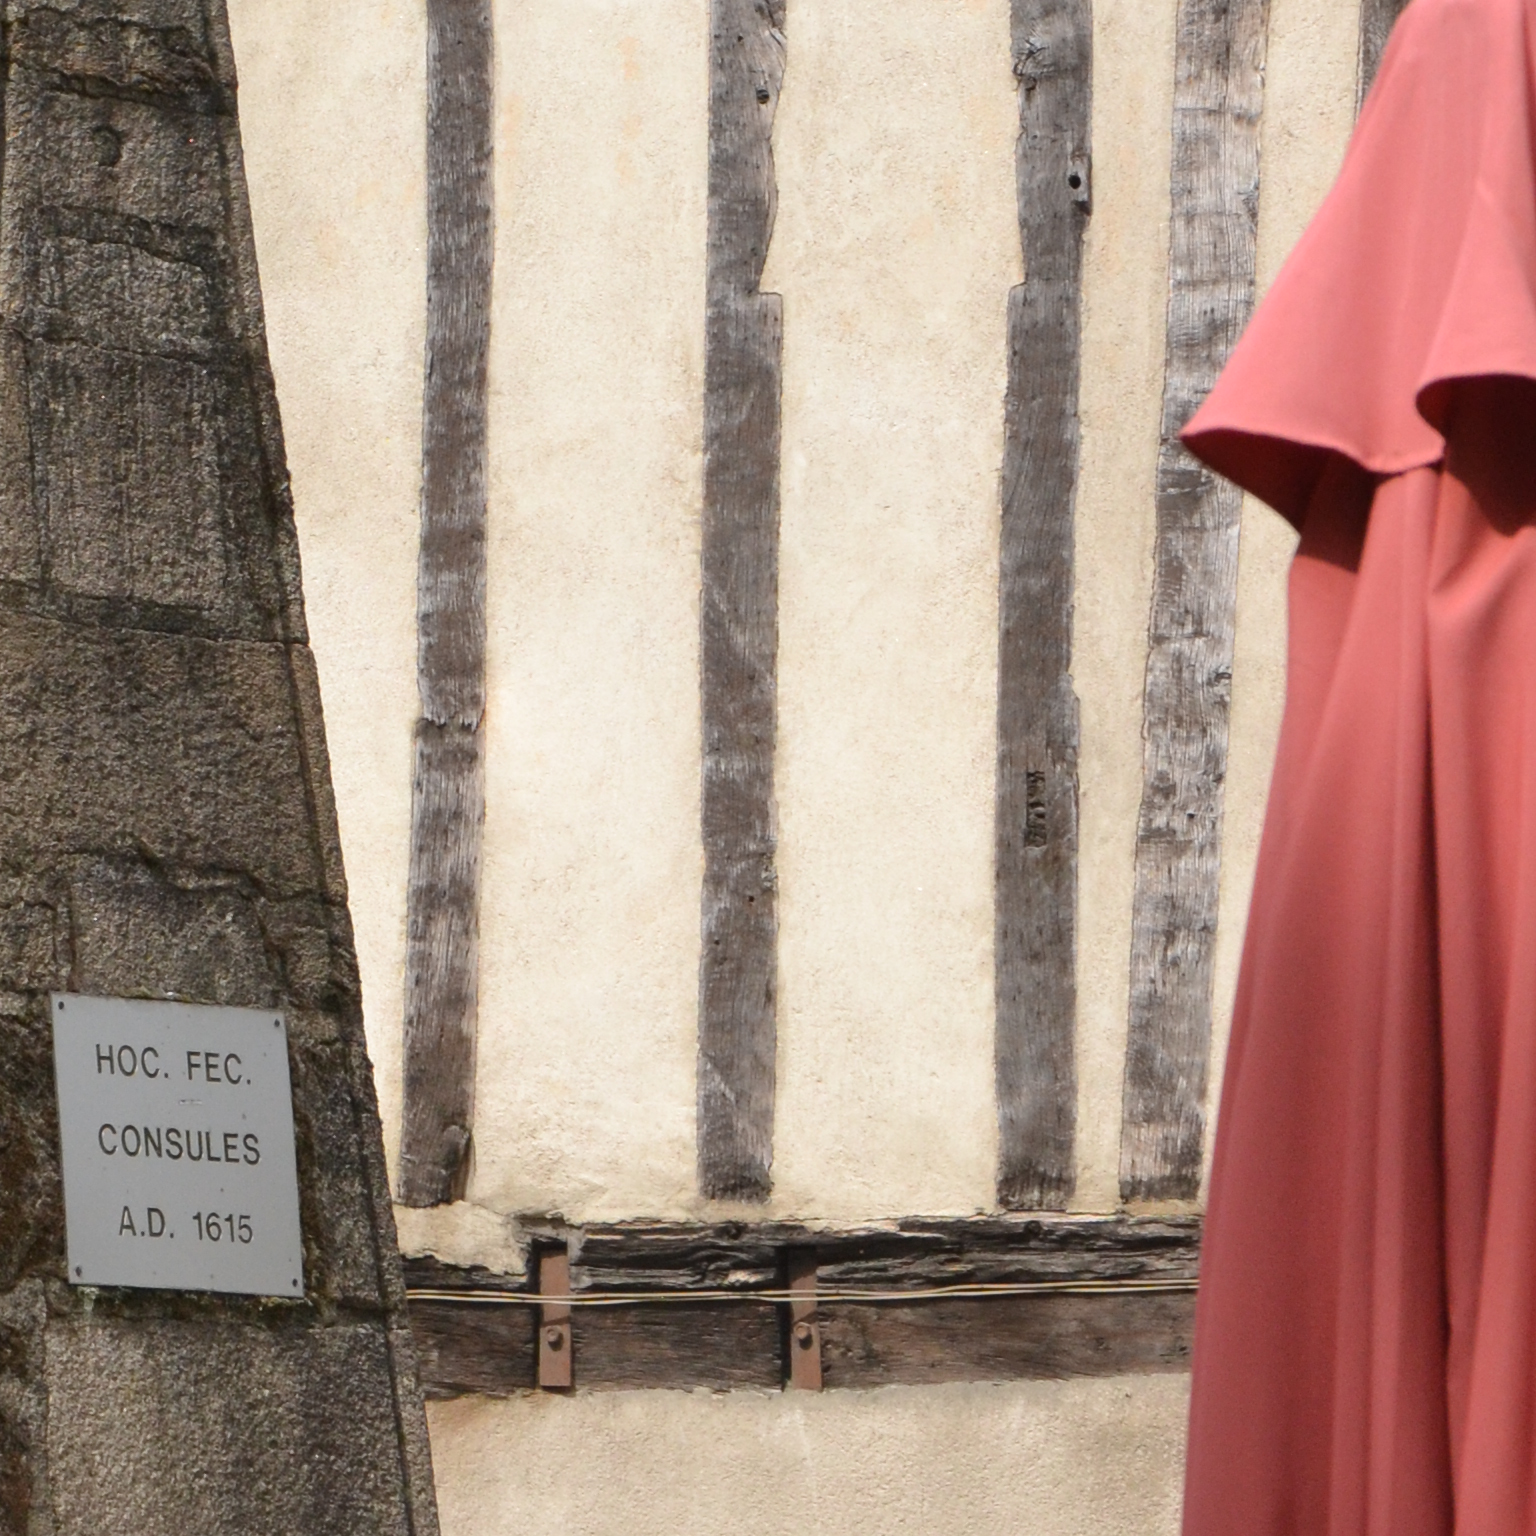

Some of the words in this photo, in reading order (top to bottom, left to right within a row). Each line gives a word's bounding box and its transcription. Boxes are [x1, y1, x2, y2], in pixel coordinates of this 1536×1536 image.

[95, 1043, 169, 1079] HOC.
[185, 1050, 252, 1085] FEC.
[97, 1123, 261, 1166] CONSULES
[118, 1205, 175, 1239] A.D.
[192, 1211, 254, 1244] 1615
